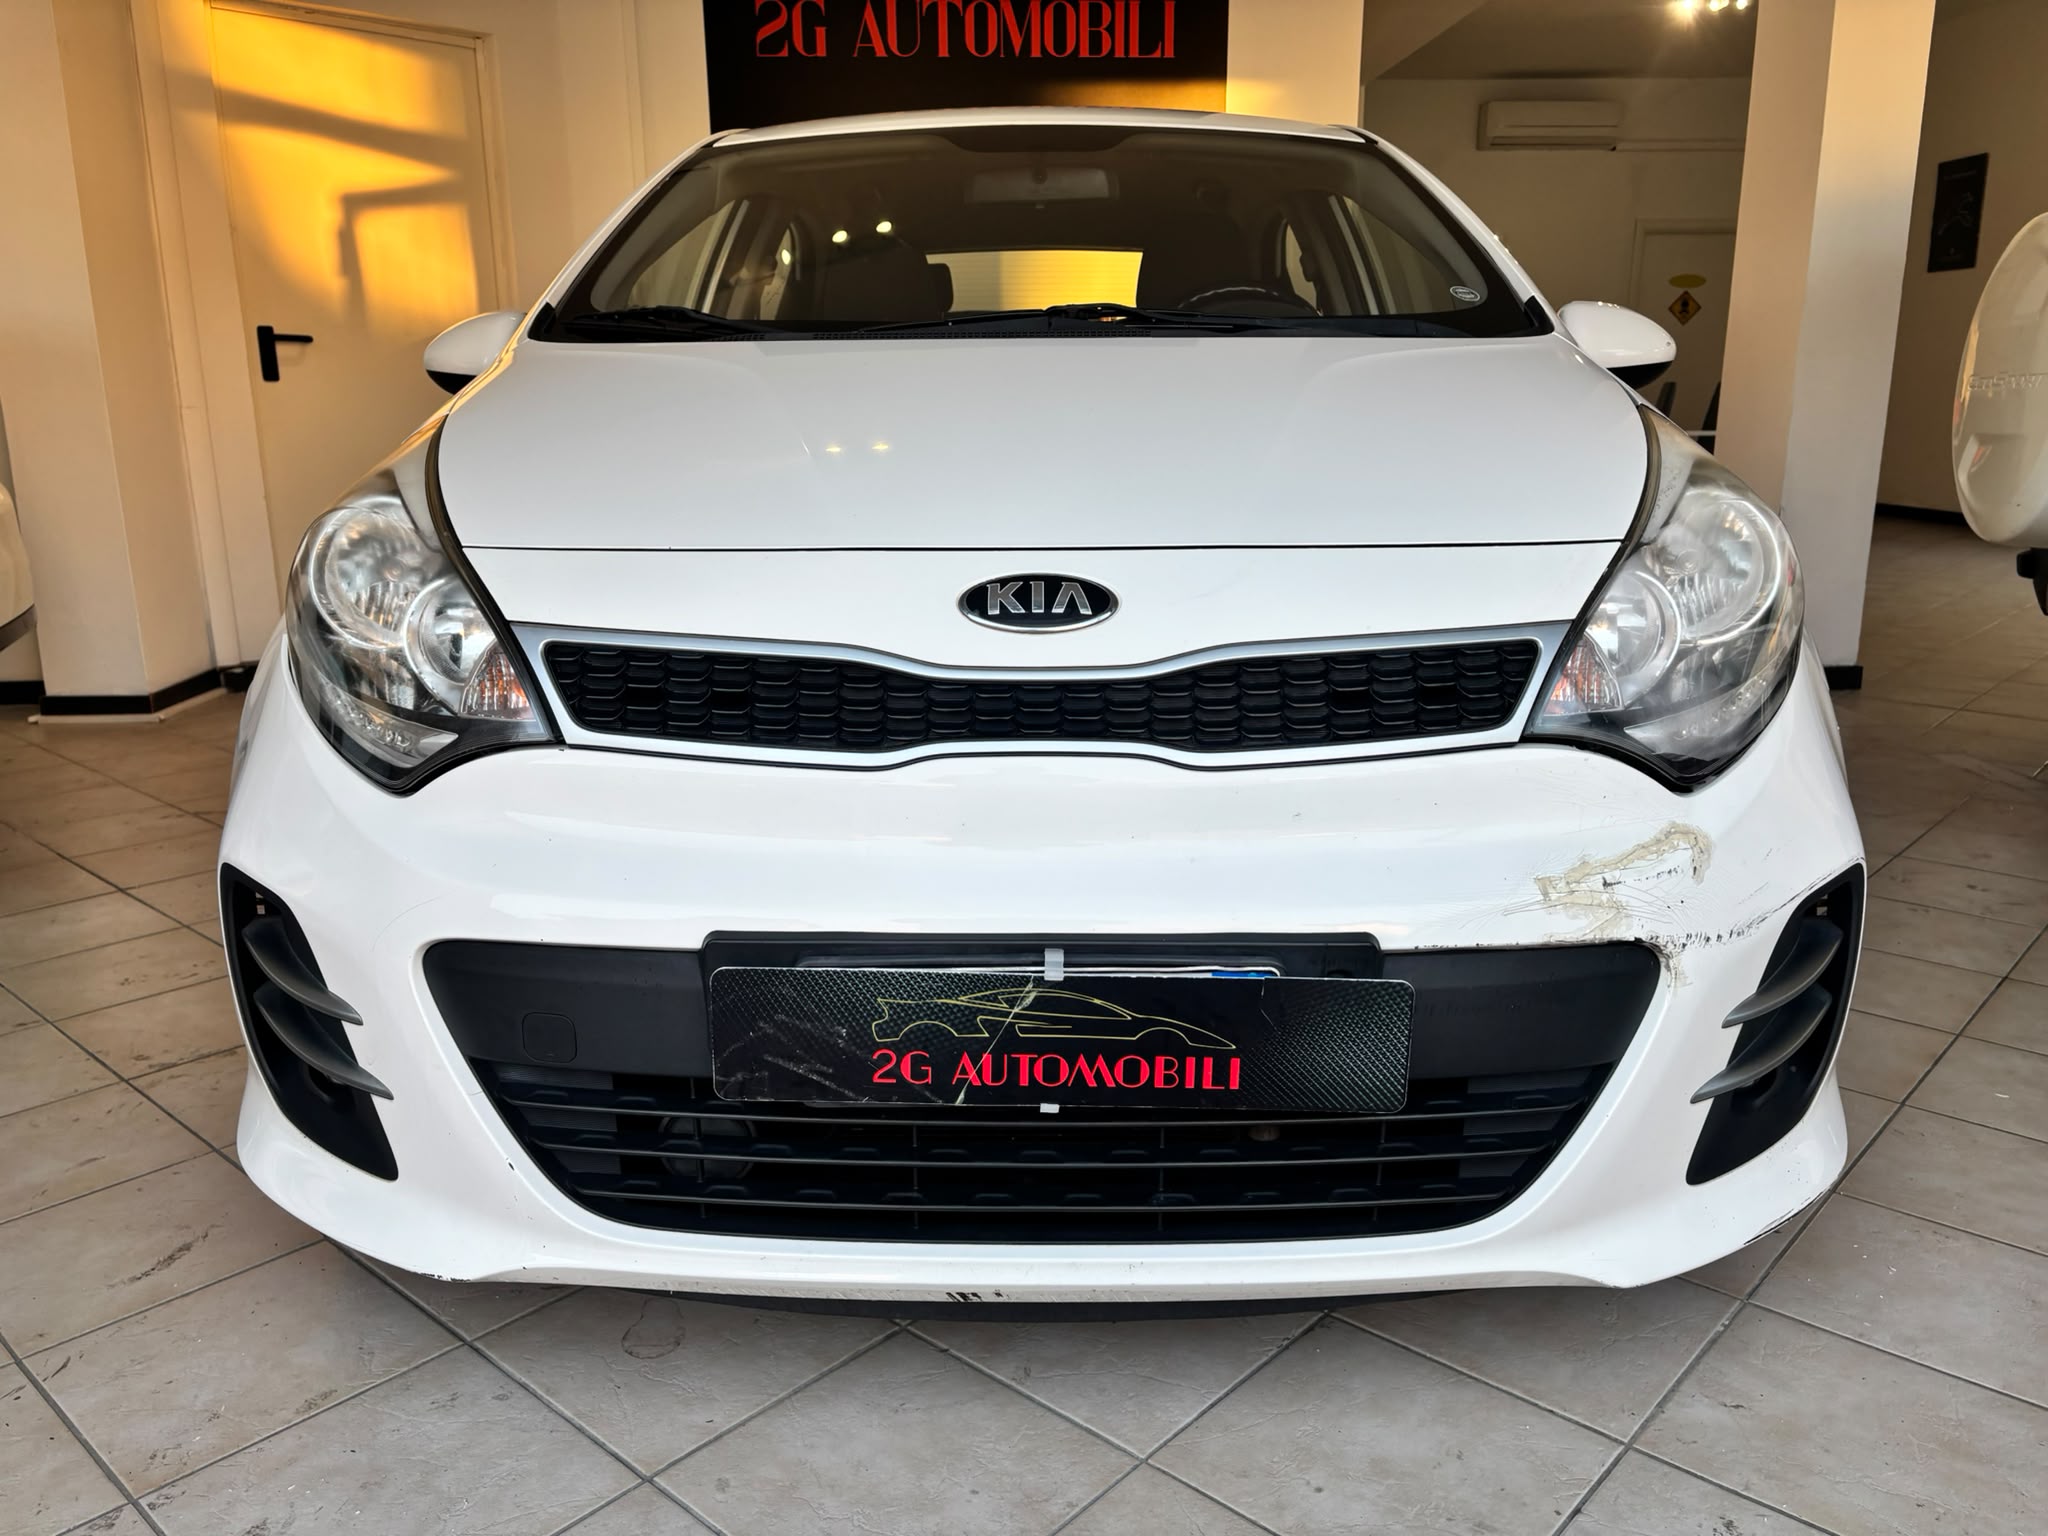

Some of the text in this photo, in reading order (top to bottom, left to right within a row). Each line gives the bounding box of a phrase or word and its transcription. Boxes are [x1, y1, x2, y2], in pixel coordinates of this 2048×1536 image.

[755, 0, 1176, 59] 2G AUTOMOBILI
[986, 581, 1093, 616] KIA
[872, 1048, 1241, 1090] 2G AUTOMOBILI
